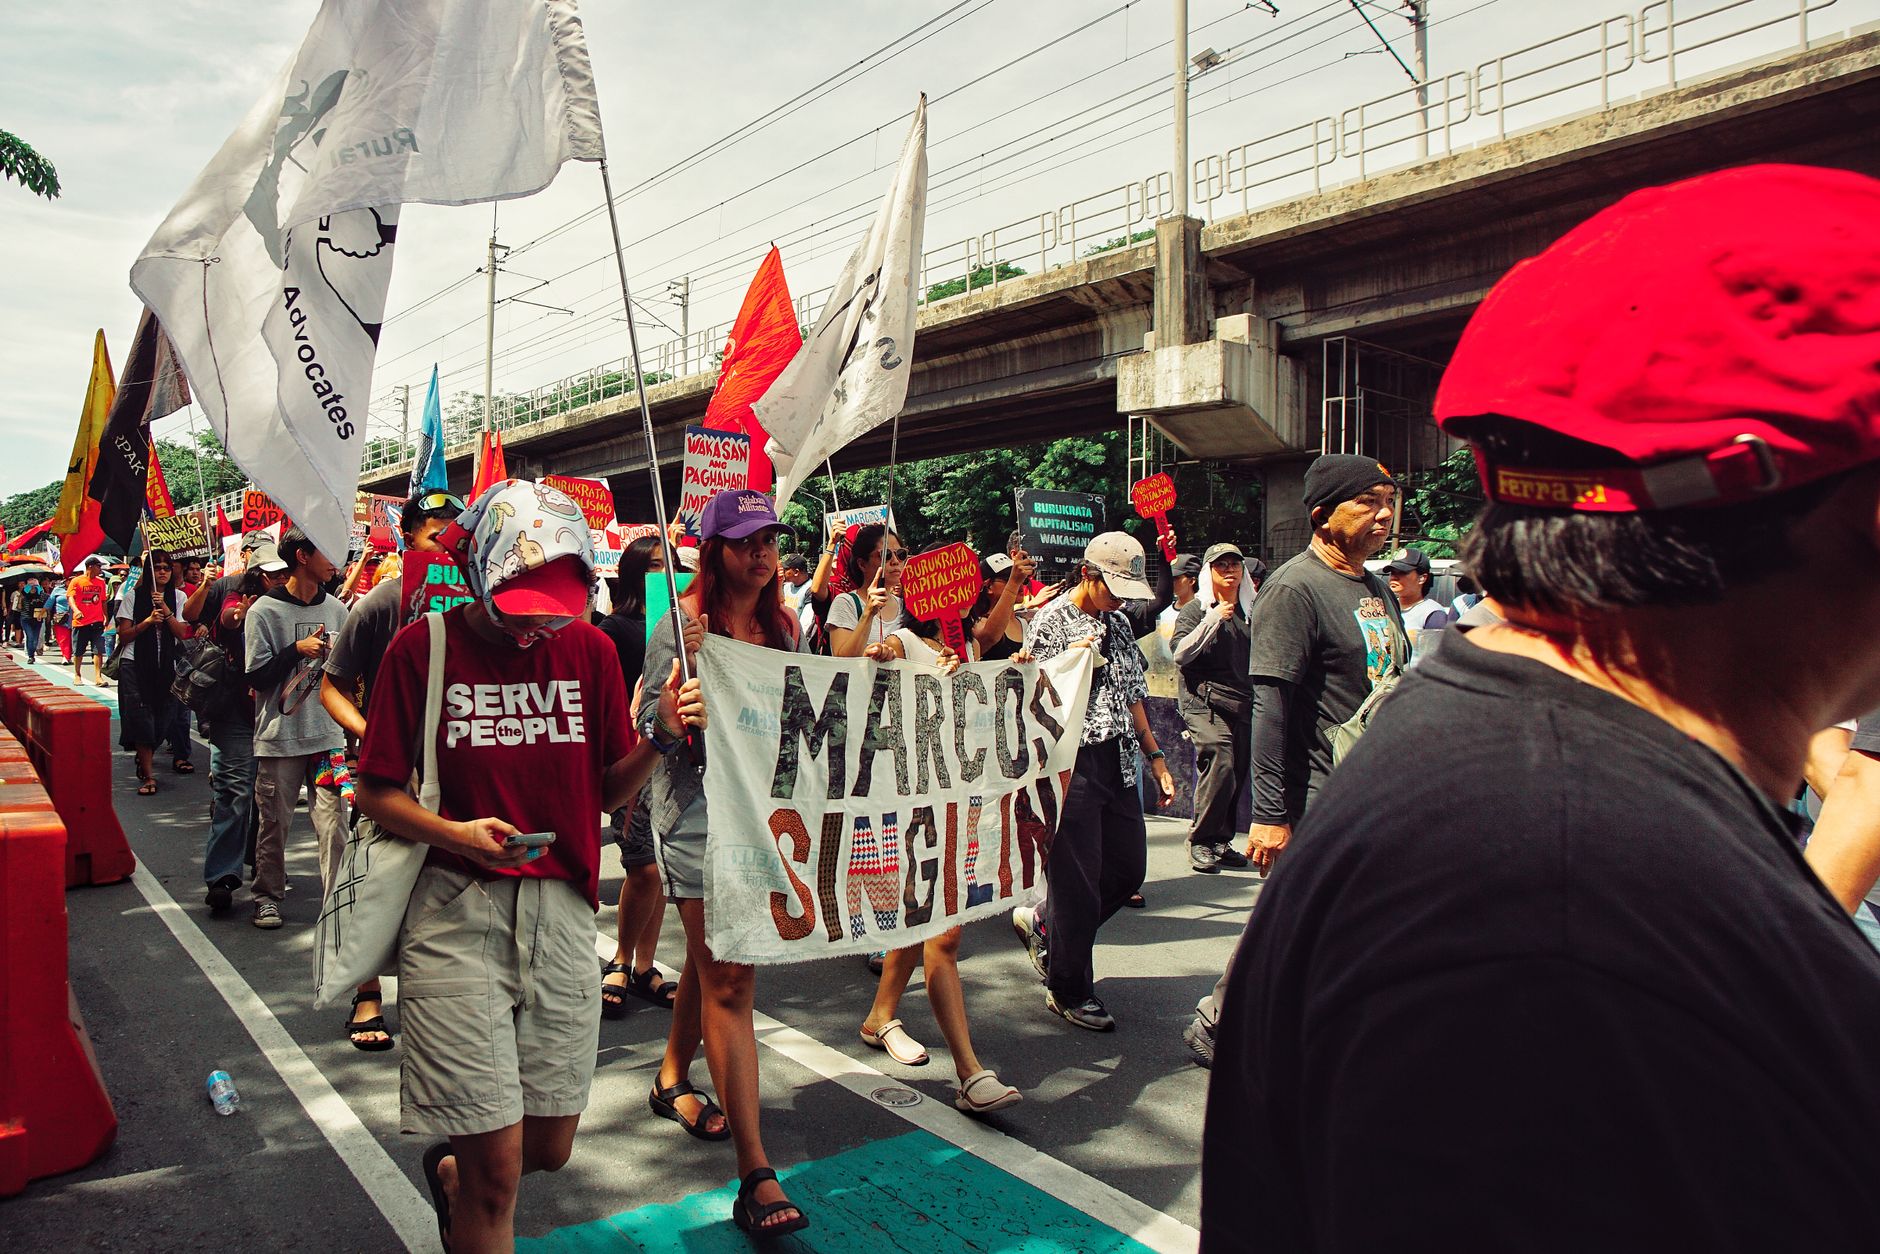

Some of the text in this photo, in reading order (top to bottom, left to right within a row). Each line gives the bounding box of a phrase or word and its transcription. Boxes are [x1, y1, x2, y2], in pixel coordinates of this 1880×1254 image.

[283, 287, 355, 440] Advocates
[687, 436, 748, 462] WAKASAN
[709, 460, 727, 469] ANG
[546, 477, 607, 501] BURUKRATA
[685, 466, 747, 490] PAGHAHARI
[739, 494, 766, 504] Palaban
[1033, 502, 1093, 518] BURUKRATA
[845, 509, 880, 525] MARCOS
[1030, 516, 1094, 533] KAPITALISMO
[906, 546, 968, 580] BURUKRATA
[904, 560, 977, 598] KAPITALISMO
[913, 581, 977, 617] IBAGSAK!
[446, 680, 583, 718] SERVE
[498, 725, 522, 737] the
[770, 665, 1065, 800] MARCOS
[768, 768, 1072, 943] SINGILIN
